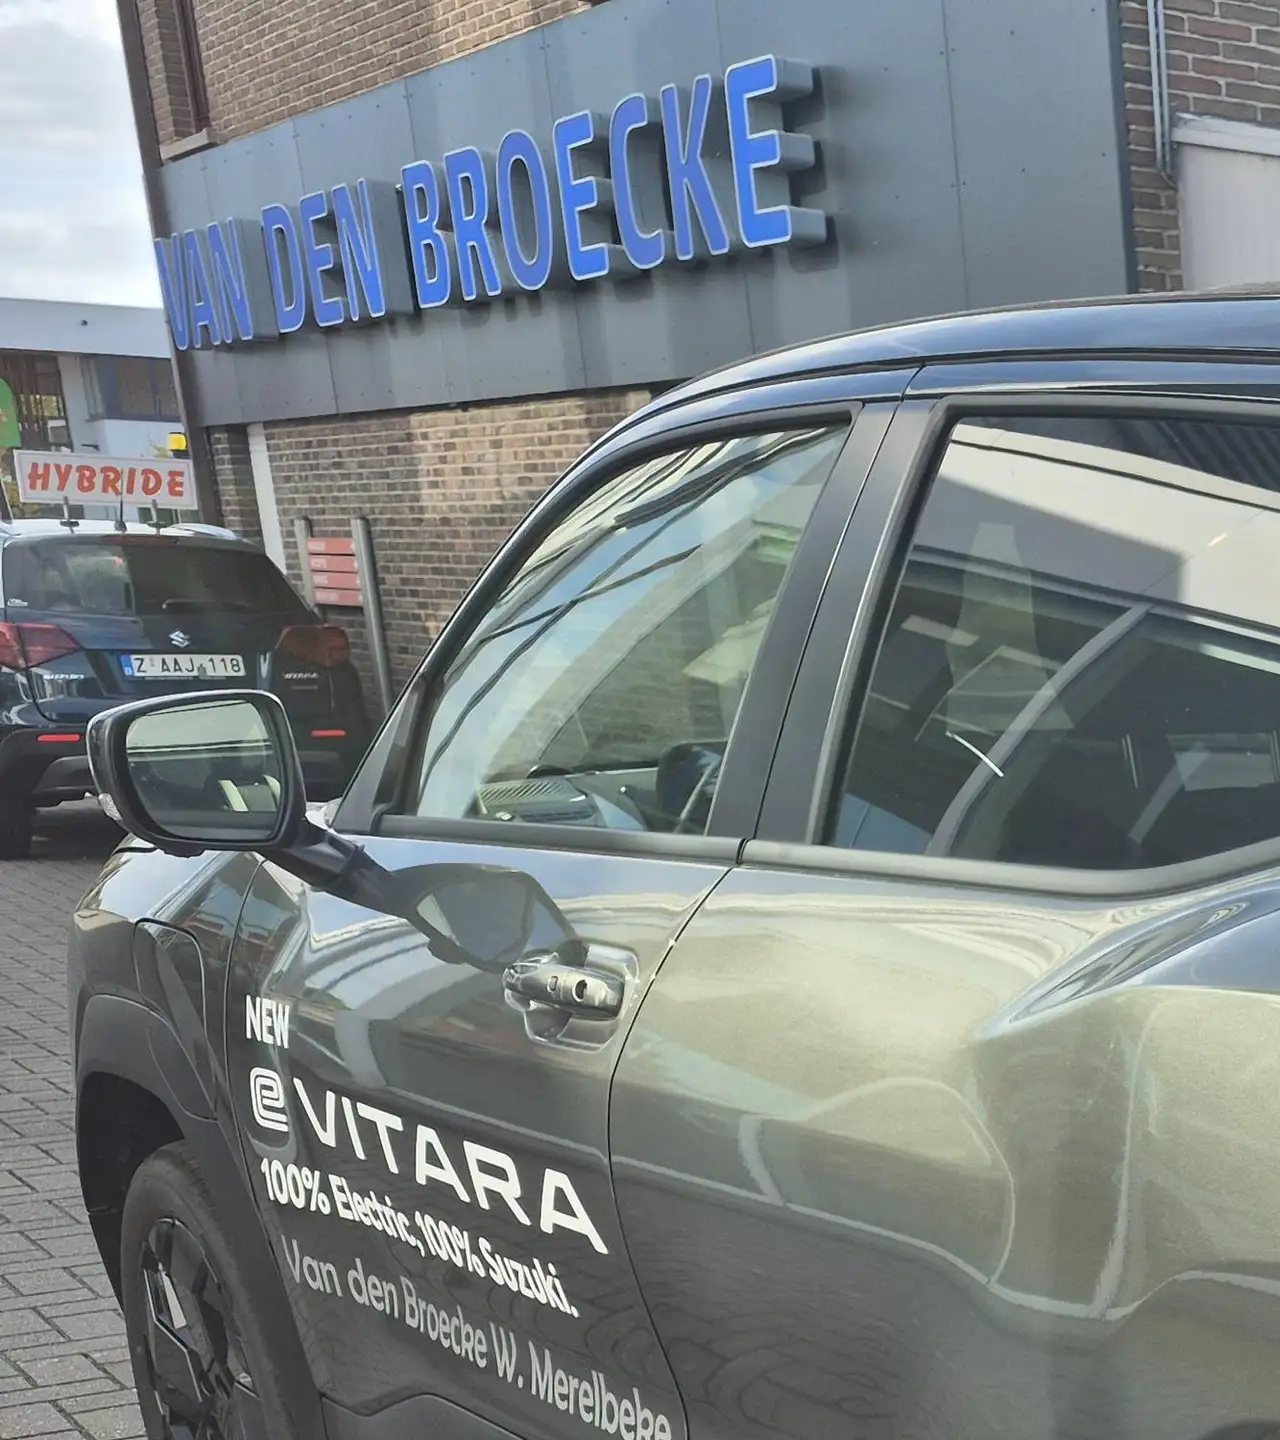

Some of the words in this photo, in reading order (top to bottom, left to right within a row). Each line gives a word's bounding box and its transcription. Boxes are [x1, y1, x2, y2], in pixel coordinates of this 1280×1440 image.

[154, 216, 254, 351] VAN
[260, 177, 386, 334] DEN
[401, 54, 793, 310] BROECKE
[27, 461, 186, 498] HYBRIDE
[245, 993, 290, 1049] NEW
[260, 1157, 331, 1216] 100%
[477, 1235, 580, 1319] Suzuki.
[292, 1075, 609, 1255] VITARA
[281, 1233, 342, 1298] Van
[347, 1257, 400, 1320] den
[399, 1274, 488, 1369] Broecke
[489, 1320, 524, 1389] W.
